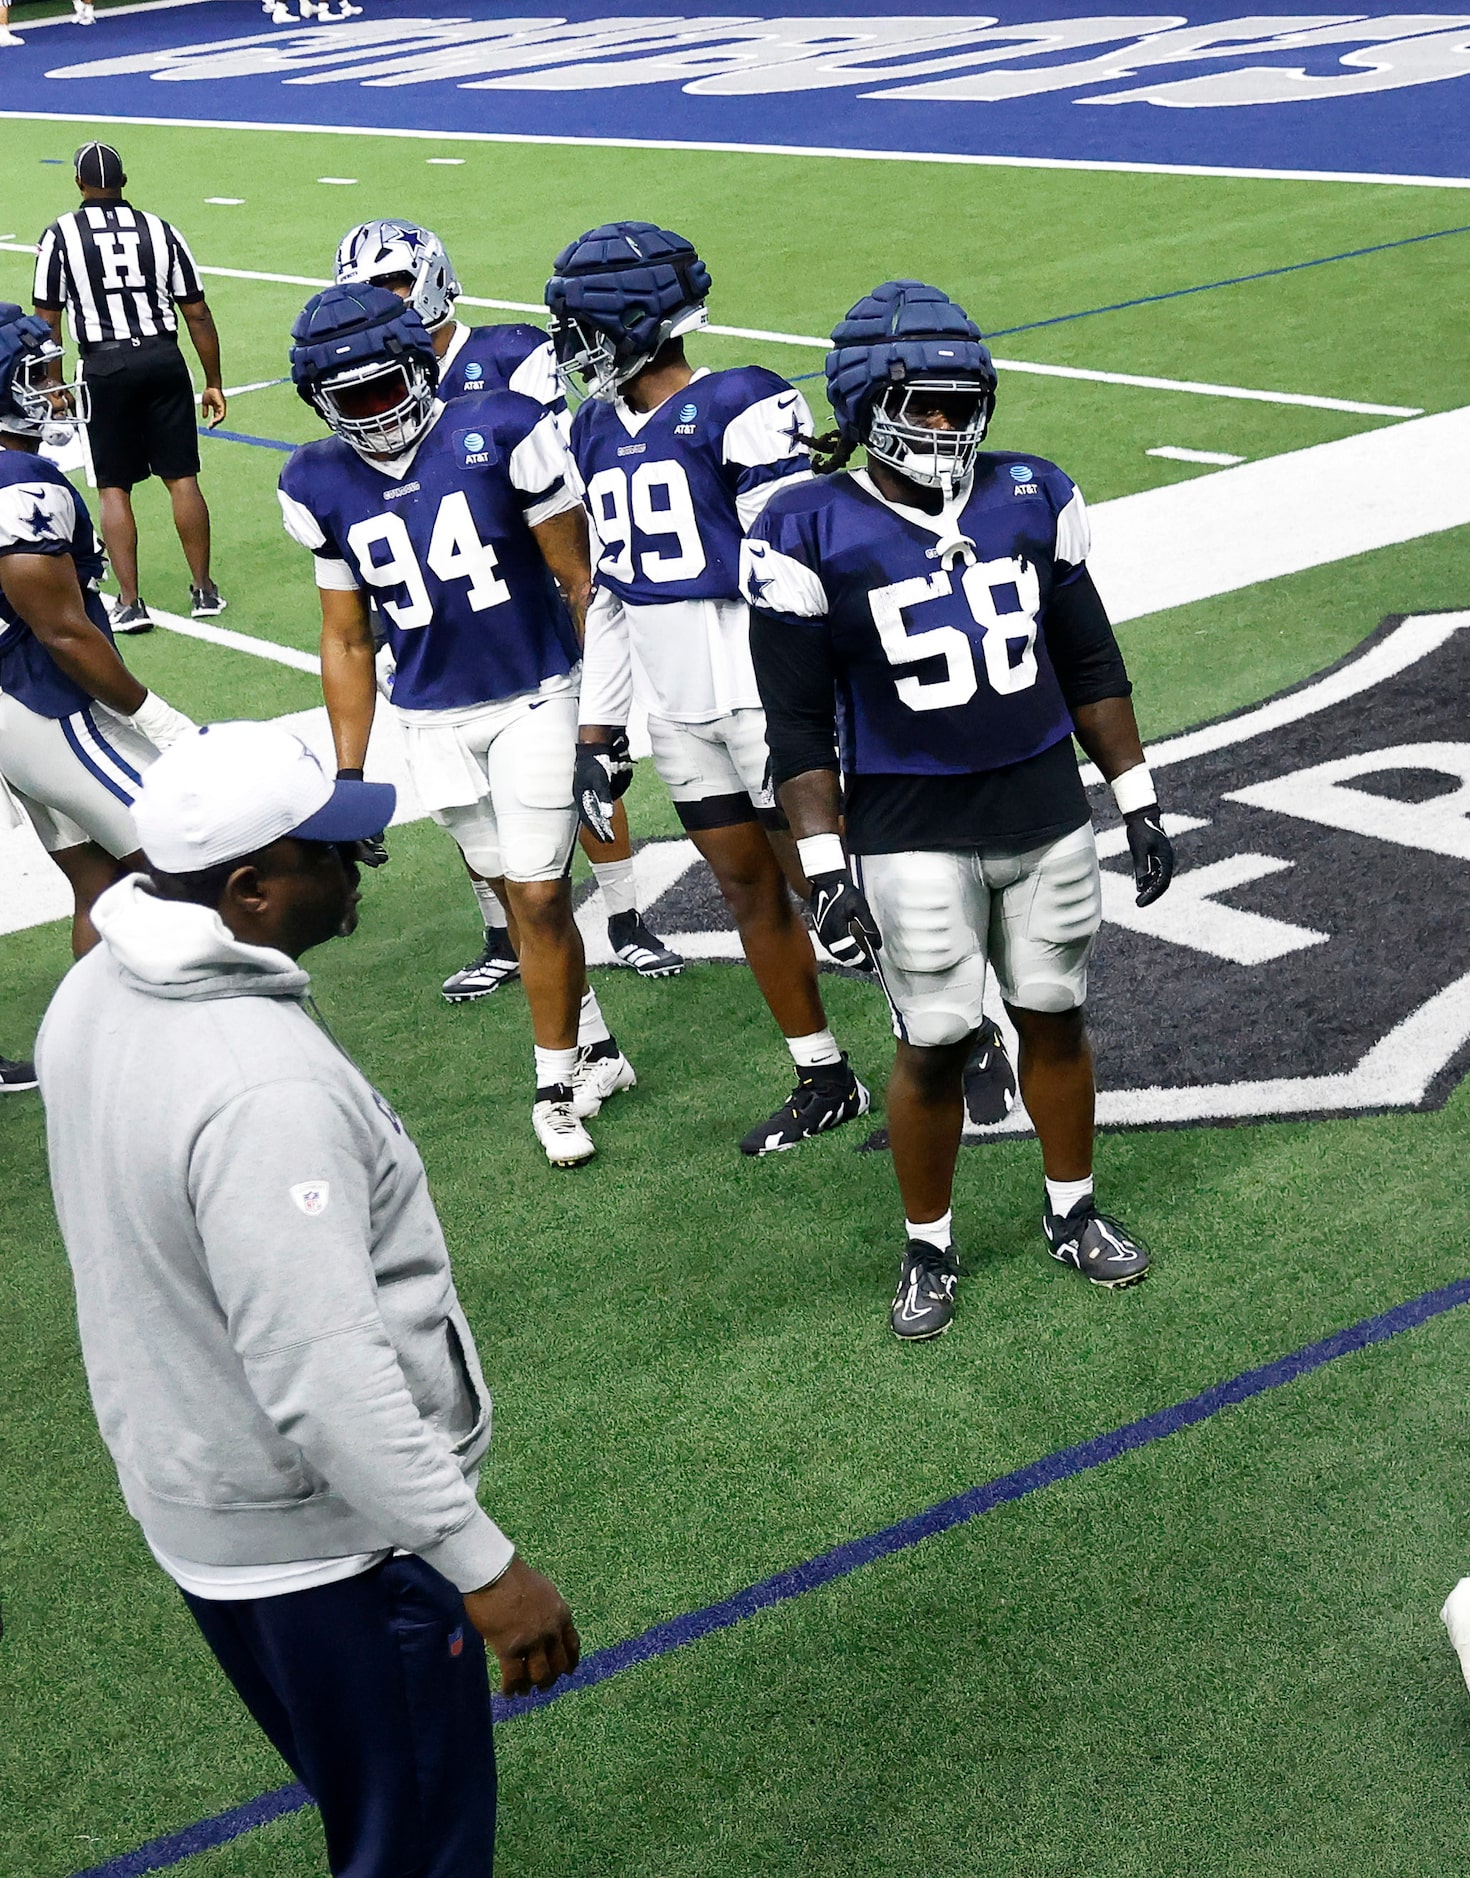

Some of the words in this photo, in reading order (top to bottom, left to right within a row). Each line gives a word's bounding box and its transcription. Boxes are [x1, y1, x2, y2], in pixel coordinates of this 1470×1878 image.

[93, 231, 146, 289] H
[464, 380, 485, 391] AT&T
[674, 424, 696, 435] AT&T
[465, 452, 489, 465] AT&T
[1014, 483, 1038, 497] AT&T
[587, 459, 708, 584] 99
[346, 490, 511, 630] 94
[867, 554, 1041, 712] 58
